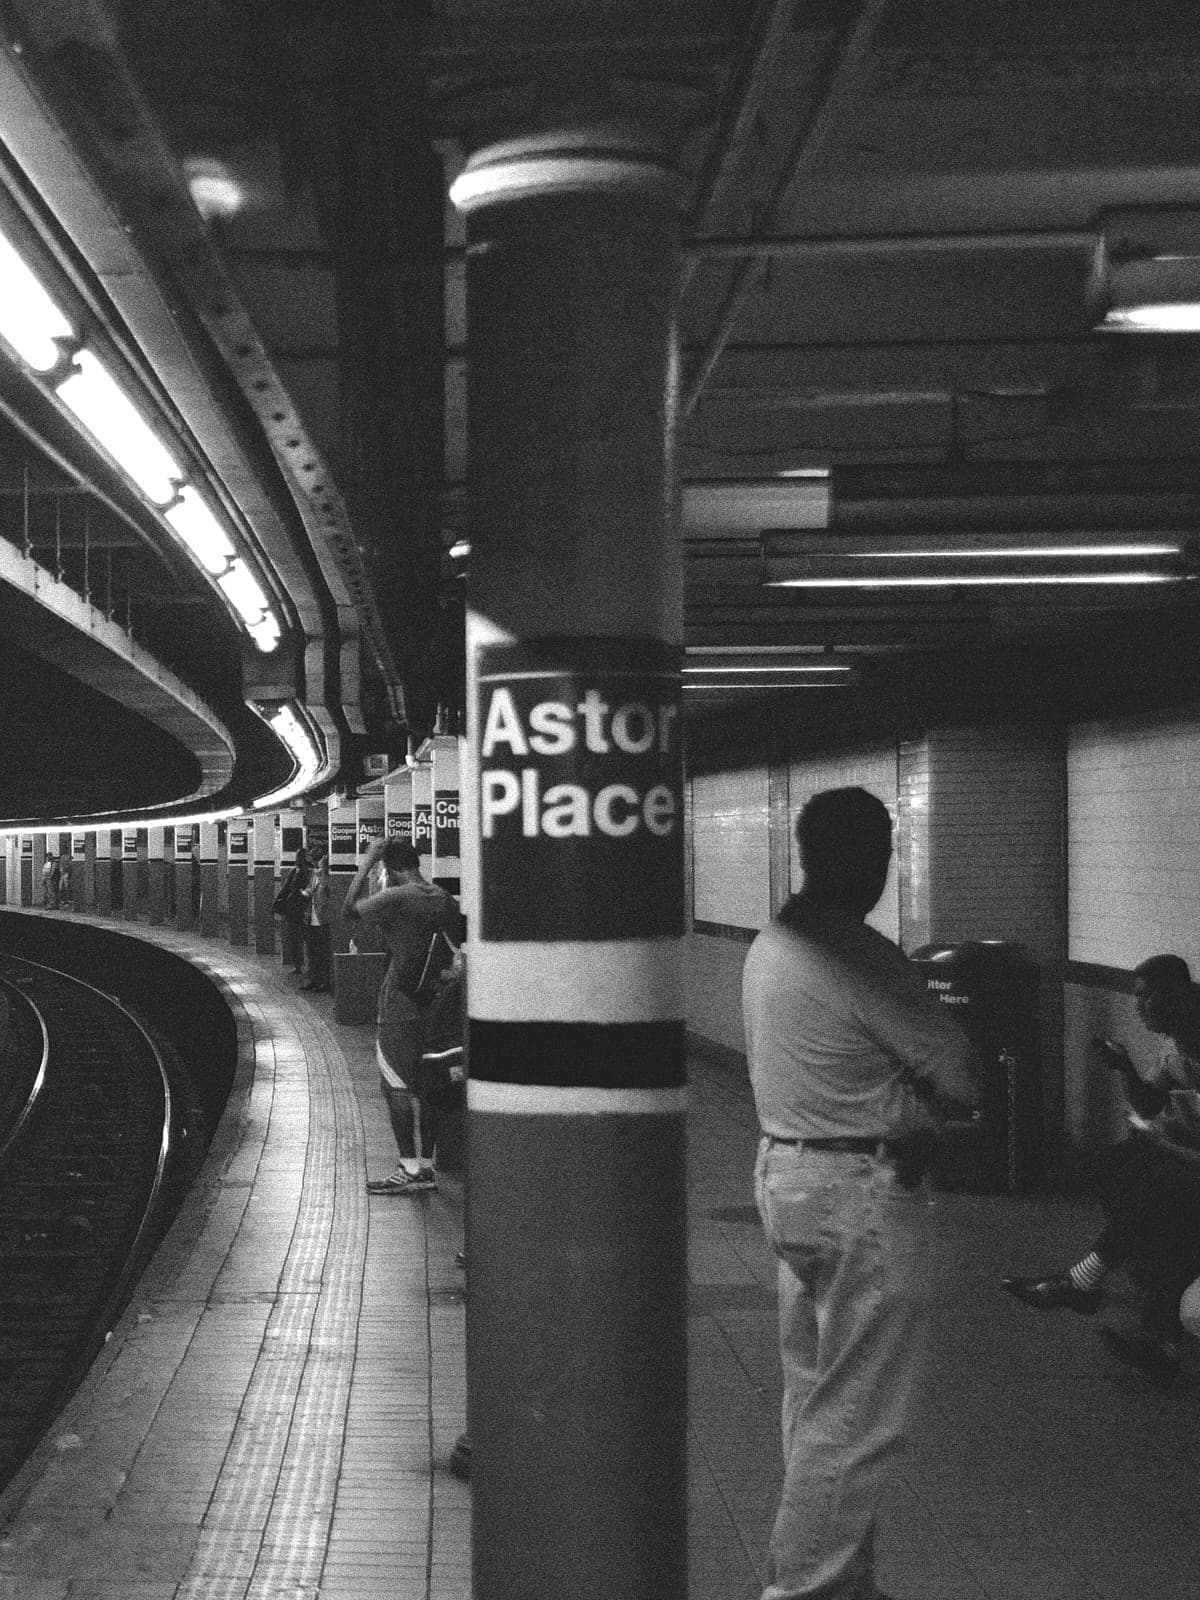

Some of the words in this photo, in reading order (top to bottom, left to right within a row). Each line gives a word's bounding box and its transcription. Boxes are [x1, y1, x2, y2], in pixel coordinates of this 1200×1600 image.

[481, 687, 677, 757] Astor
[481, 768, 676, 838] Place
[416, 826, 431, 839] Pl
[939, 993, 969, 1004] Here
